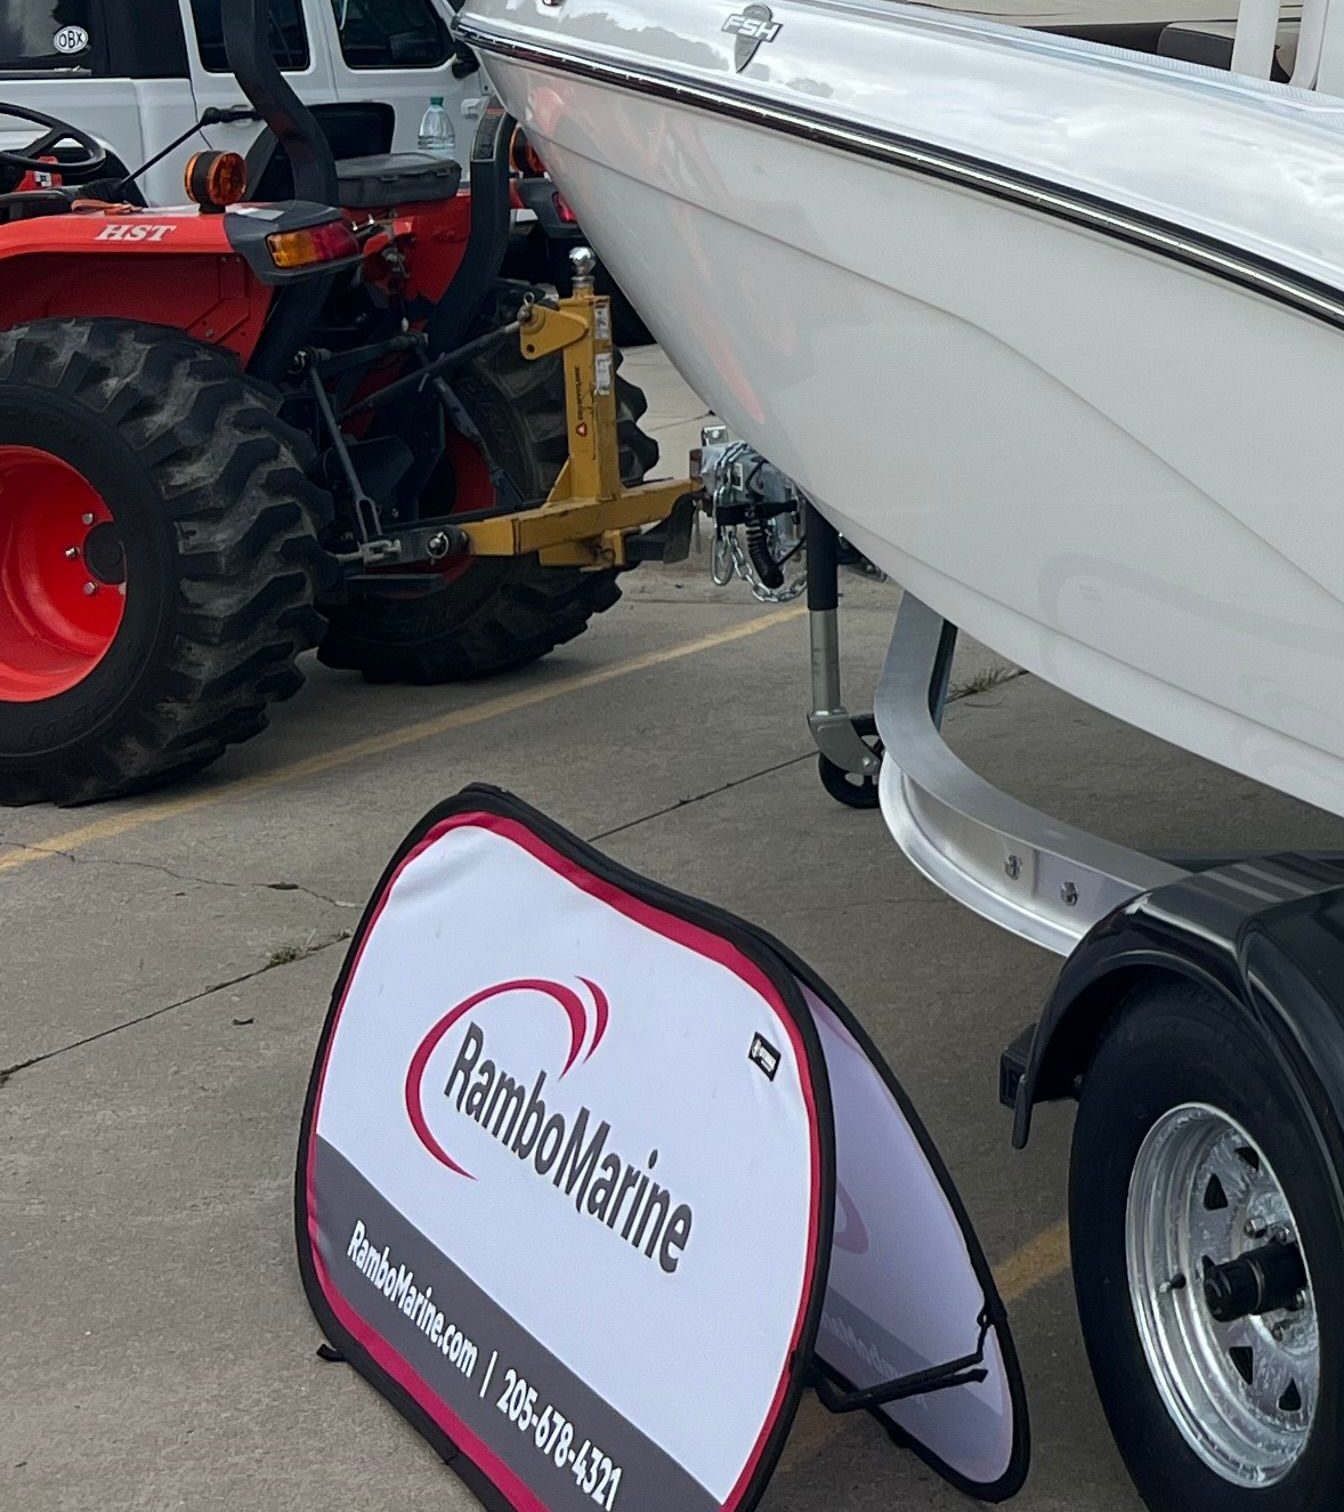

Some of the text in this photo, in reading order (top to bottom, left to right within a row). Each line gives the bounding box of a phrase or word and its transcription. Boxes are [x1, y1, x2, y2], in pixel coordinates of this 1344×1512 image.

[59, 30, 83, 48] OBX
[728, 15, 781, 42] FSH
[95, 224, 177, 242] HST
[443, 1021, 693, 1274] RamboMarine
[346, 1219, 623, 1512] RamboMarine.com 205-678-4321
